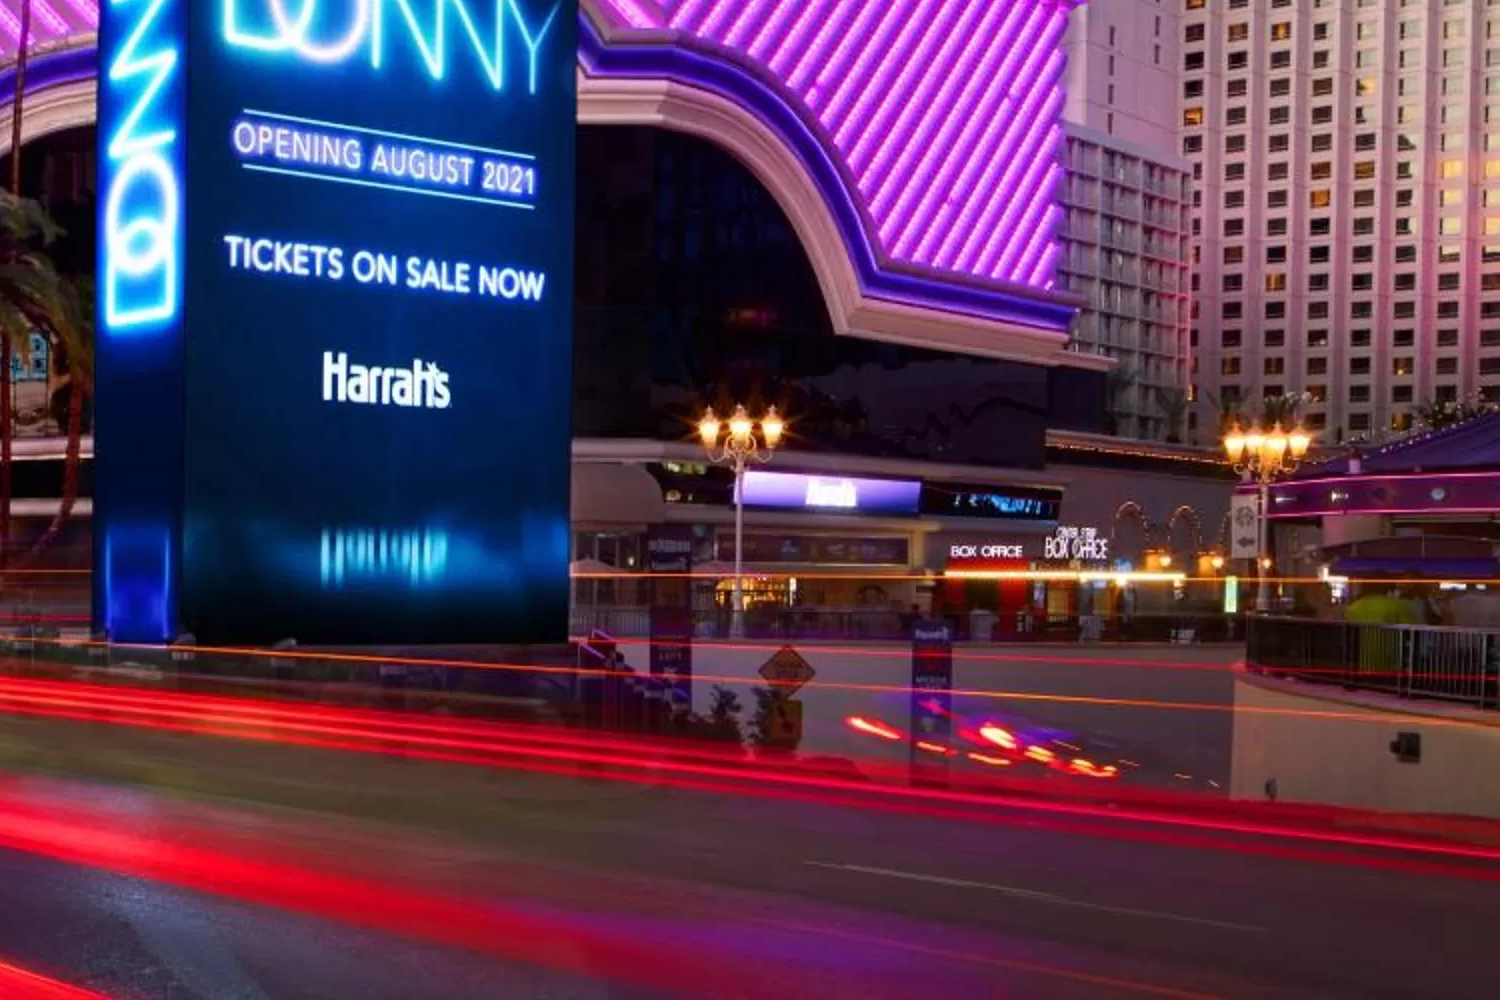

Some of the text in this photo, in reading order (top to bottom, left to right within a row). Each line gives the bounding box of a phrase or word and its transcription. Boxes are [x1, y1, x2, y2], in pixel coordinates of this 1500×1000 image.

[233, 121, 536, 196] OPENING AUGUST 2021
[223, 234, 546, 302] TICKETS ON SALE NOW
[951, 545, 1023, 558] BOX OFFICE
[1044, 536, 1109, 560] BOX OFFICE
